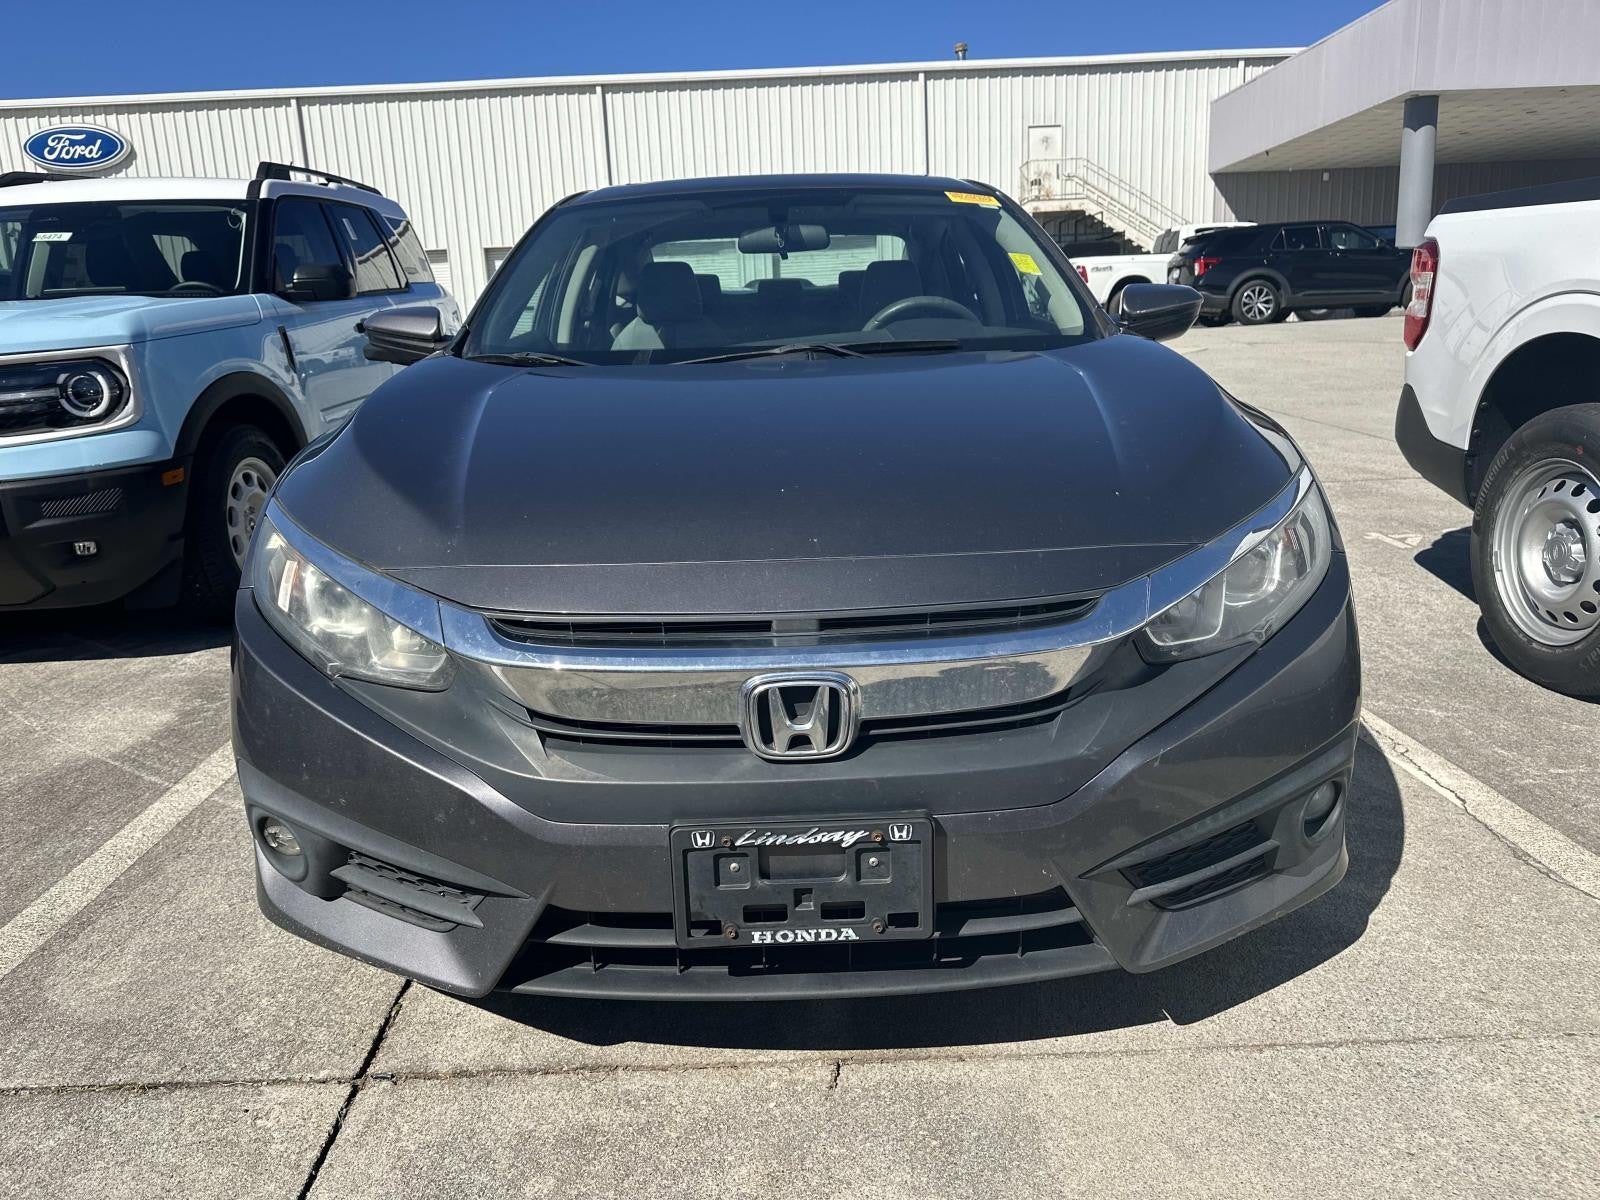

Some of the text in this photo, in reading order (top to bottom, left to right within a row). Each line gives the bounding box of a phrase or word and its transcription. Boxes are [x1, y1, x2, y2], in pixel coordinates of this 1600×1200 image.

[44, 134, 102, 160] Ford
[735, 827, 869, 847] Lindsay
[751, 928, 860, 944] HONDA
